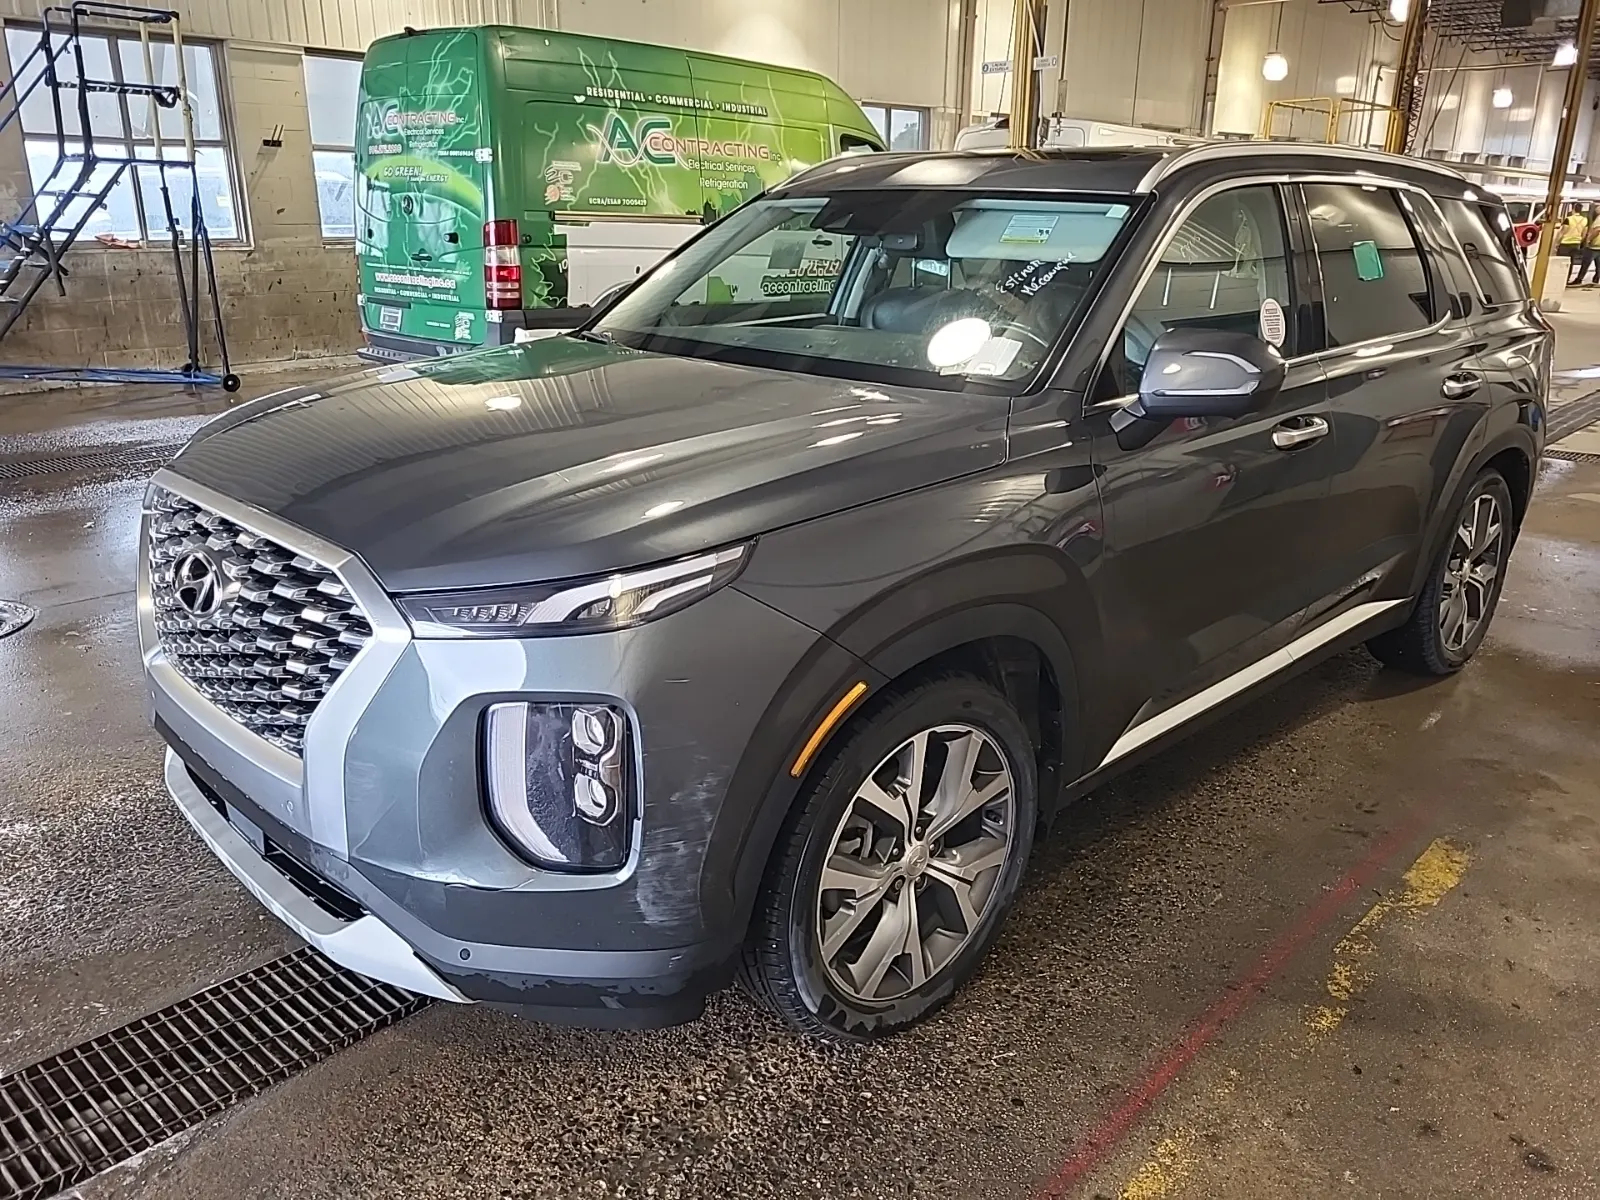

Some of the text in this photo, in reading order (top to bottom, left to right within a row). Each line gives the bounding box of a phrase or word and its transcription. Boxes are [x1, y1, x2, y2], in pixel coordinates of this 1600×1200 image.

[586, 86, 768, 116] RESIDENTIAL COMMERCIAL INDUSTRIAL
[386, 110, 456, 127] CONTRACTING
[649, 136, 769, 160] CONTRACTING
[383, 166, 423, 177] GO GREEN!
[688, 159, 756, 174] Electrical Services
[700, 178, 748, 190] Refrigeration
